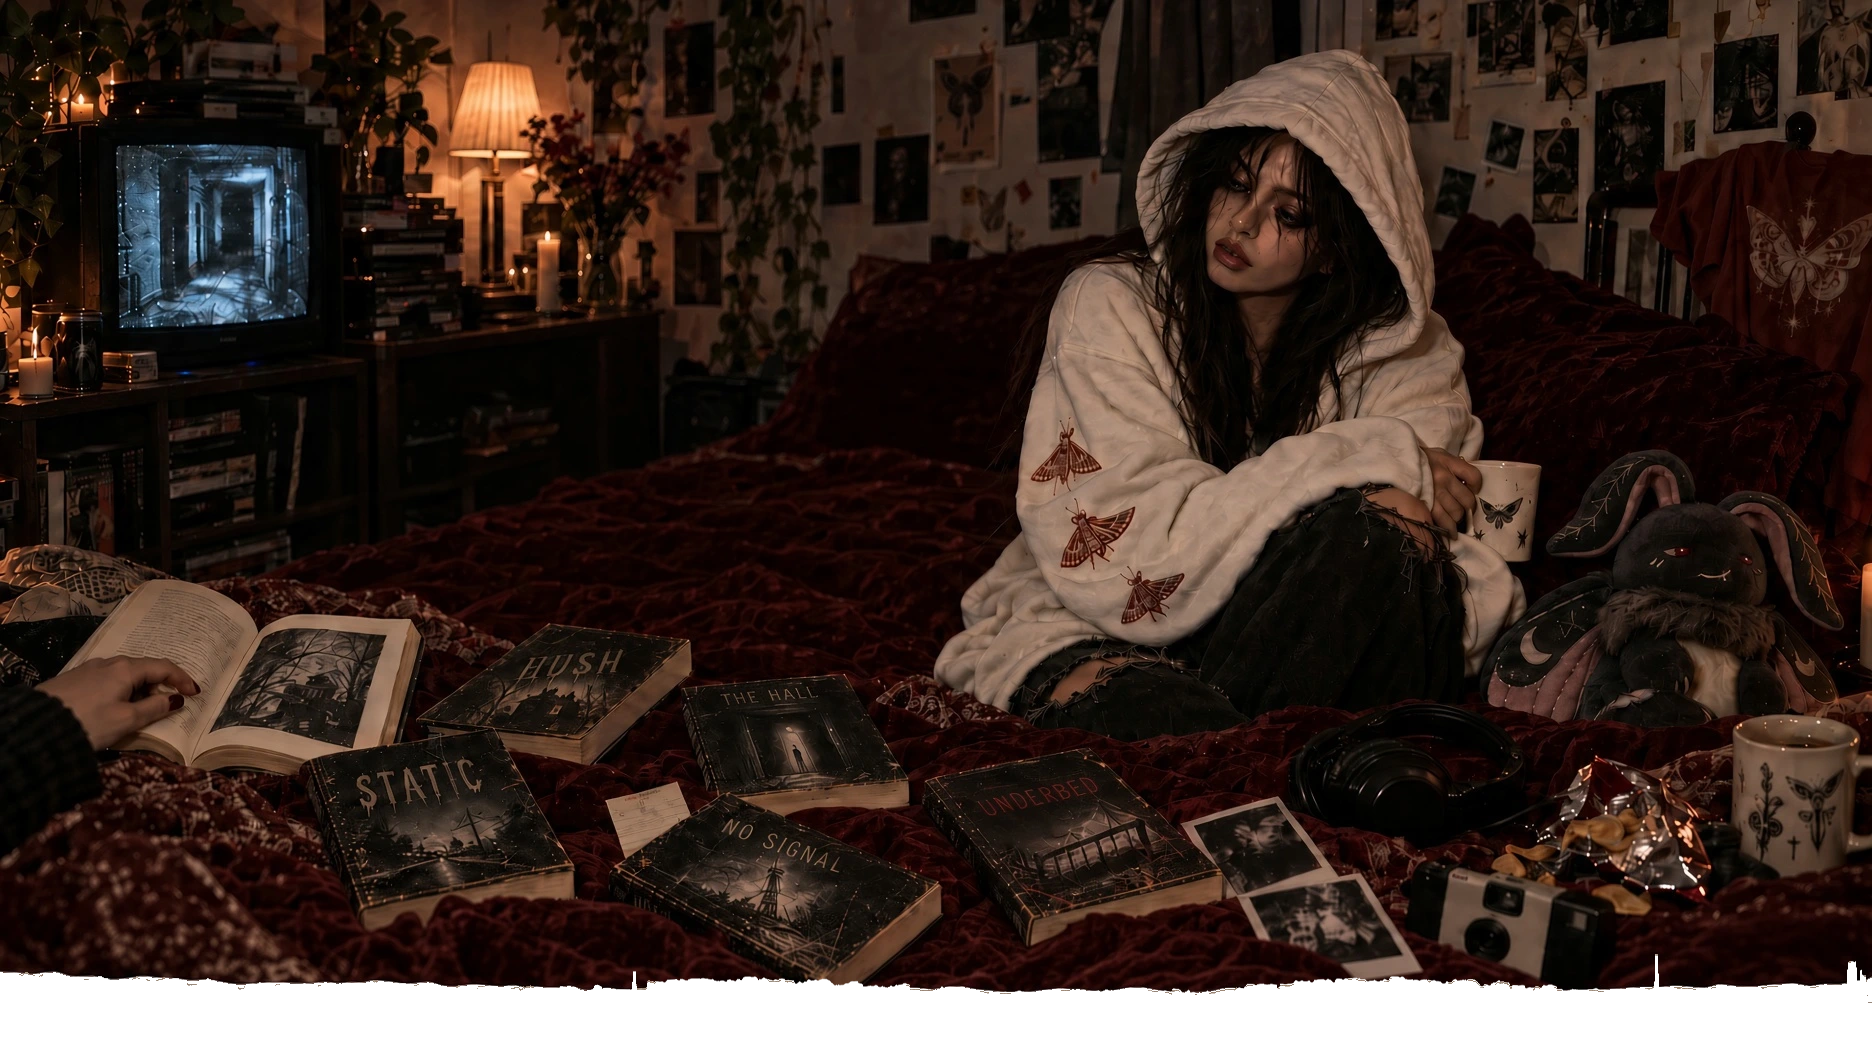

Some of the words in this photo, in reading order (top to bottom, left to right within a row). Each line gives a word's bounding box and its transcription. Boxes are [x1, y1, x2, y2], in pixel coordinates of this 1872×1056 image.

[517, 648, 624, 681] HUSH
[720, 691, 760, 706] THE
[767, 686, 819, 701] HALL
[356, 757, 482, 816] STATIC
[977, 777, 1099, 816] UNDERBED
[721, 818, 754, 840] NO
[762, 833, 841, 873] SIGNAL
